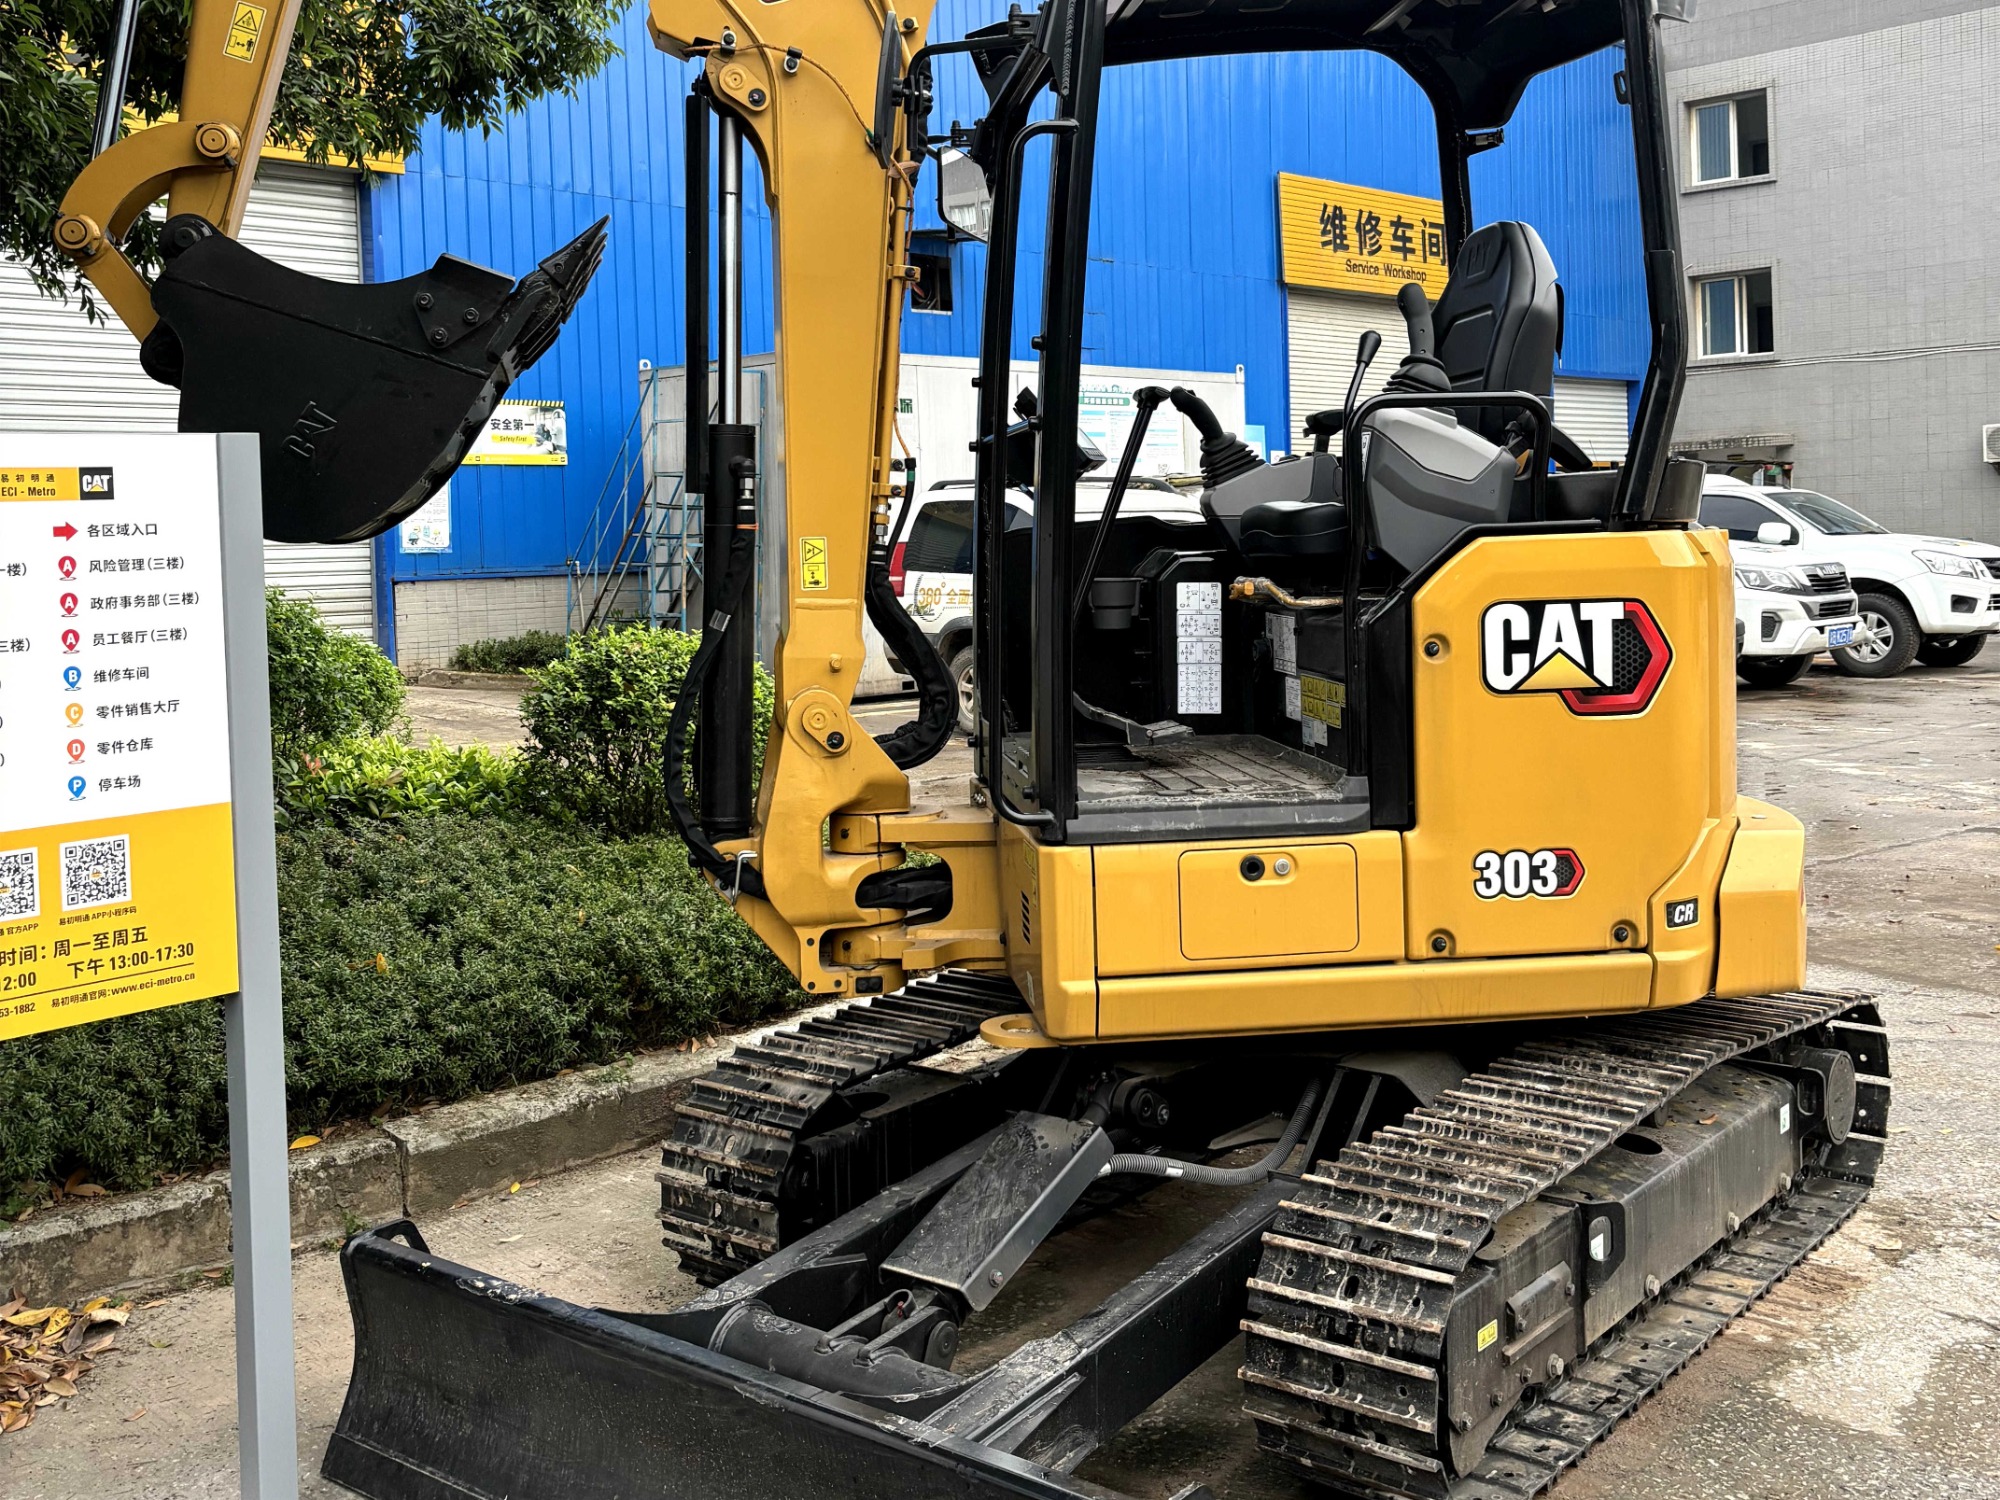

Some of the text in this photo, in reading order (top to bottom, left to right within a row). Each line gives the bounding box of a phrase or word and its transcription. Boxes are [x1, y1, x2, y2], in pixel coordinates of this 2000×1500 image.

[1319, 202, 1448, 266] 维修车间
[1345, 258, 1428, 284] Service Workshop
[490, 418, 535, 431] 安全第一
[499, 435, 515, 444] Safety
[1, 473, 55, 483] 易初明通
[82, 474, 112, 493] CAT
[1, 487, 18, 497] ECI
[28, 487, 56, 497] Metro
[87, 522, 159, 538] 各区域入口
[62, 556, 185, 573] A 风险管理(三楼)
[64, 591, 200, 610] A 政府事务部(三楼)
[946, 588, 972, 604] 全面
[66, 627, 188, 647] A 员工餐厅(三楼)
[1483, 601, 1625, 691] CAT
[68, 666, 150, 683] B 维修车间
[70, 699, 180, 719] C 零件销售大厅
[72, 737, 154, 756] D 零件仓库
[73, 775, 141, 792] P 停车场
[1474, 850, 1558, 896] 303
[1673, 903, 1695, 924] CR
[67, 958, 105, 980] 下午
[109, 942, 195, 971] 13:00-17:30
